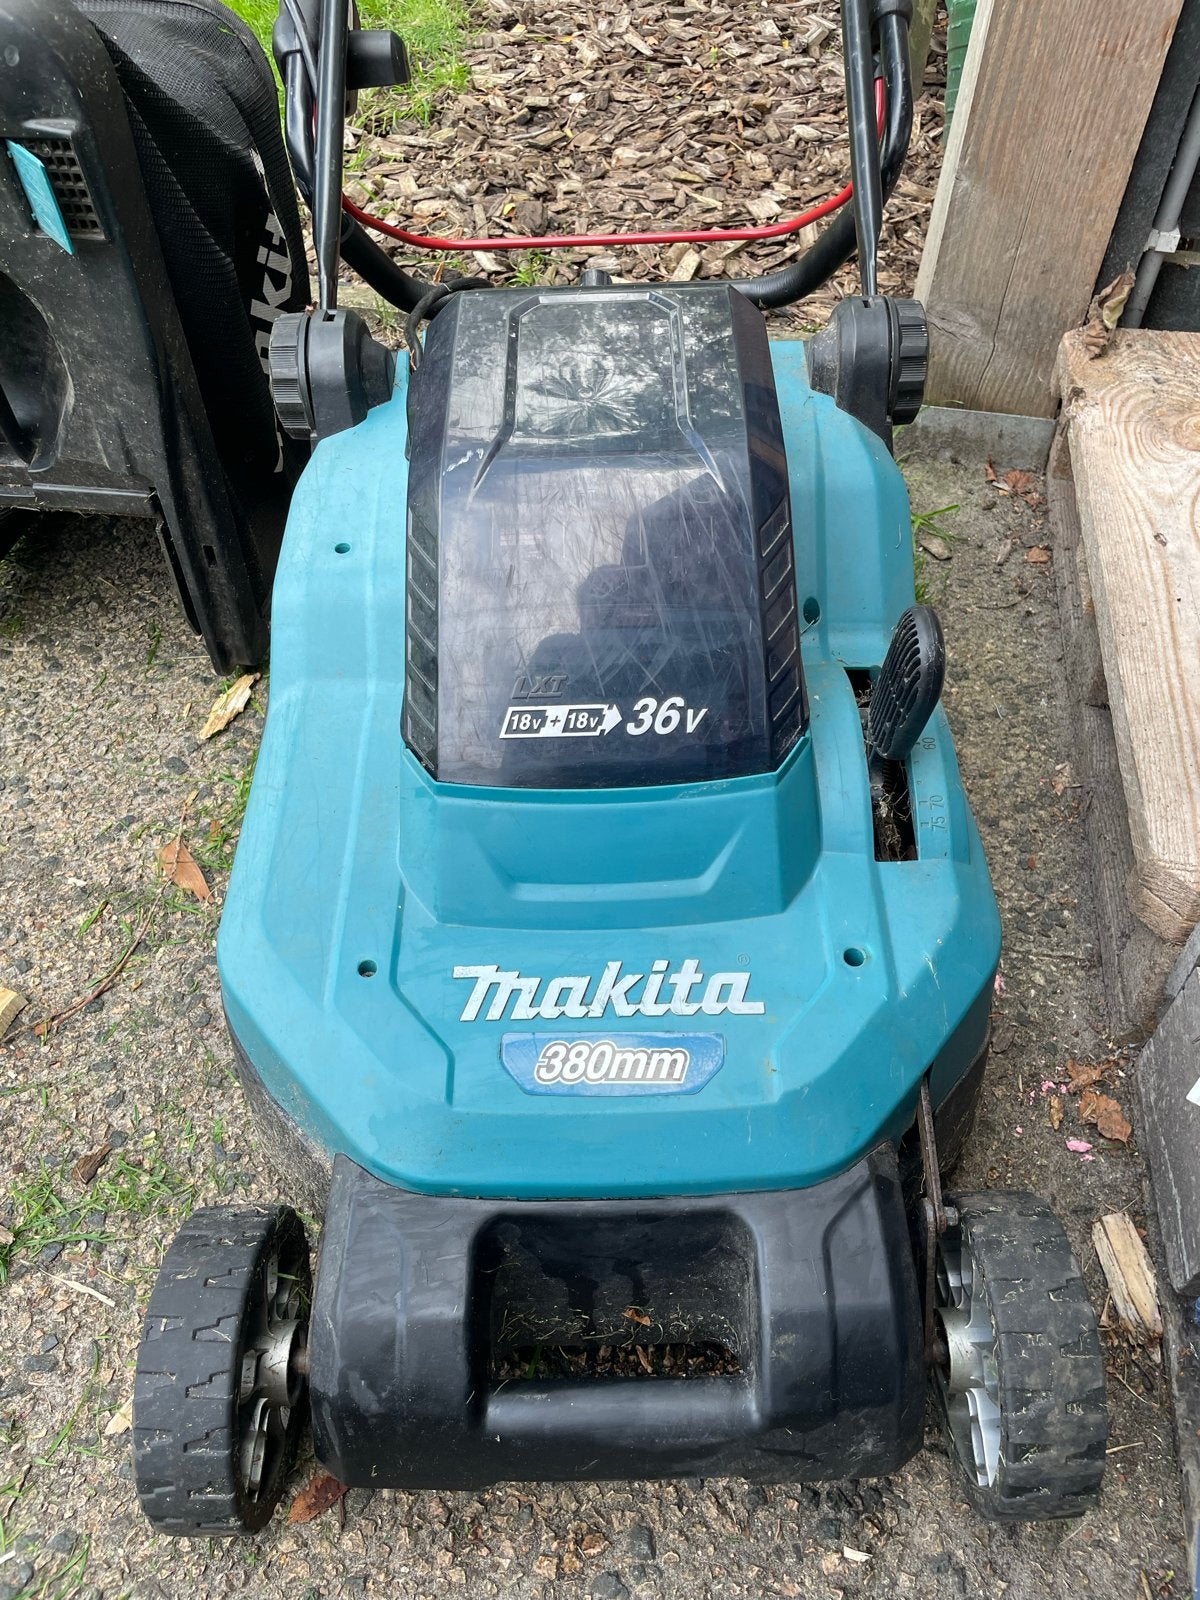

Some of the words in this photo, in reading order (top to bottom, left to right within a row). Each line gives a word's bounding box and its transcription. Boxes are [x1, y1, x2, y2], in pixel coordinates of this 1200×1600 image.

[512, 675, 568, 699] LXT
[921, 737, 936, 751] 60
[929, 794, 944, 810] 70
[930, 816, 945, 832] 75
[537, 1041, 688, 1082] 380mm
